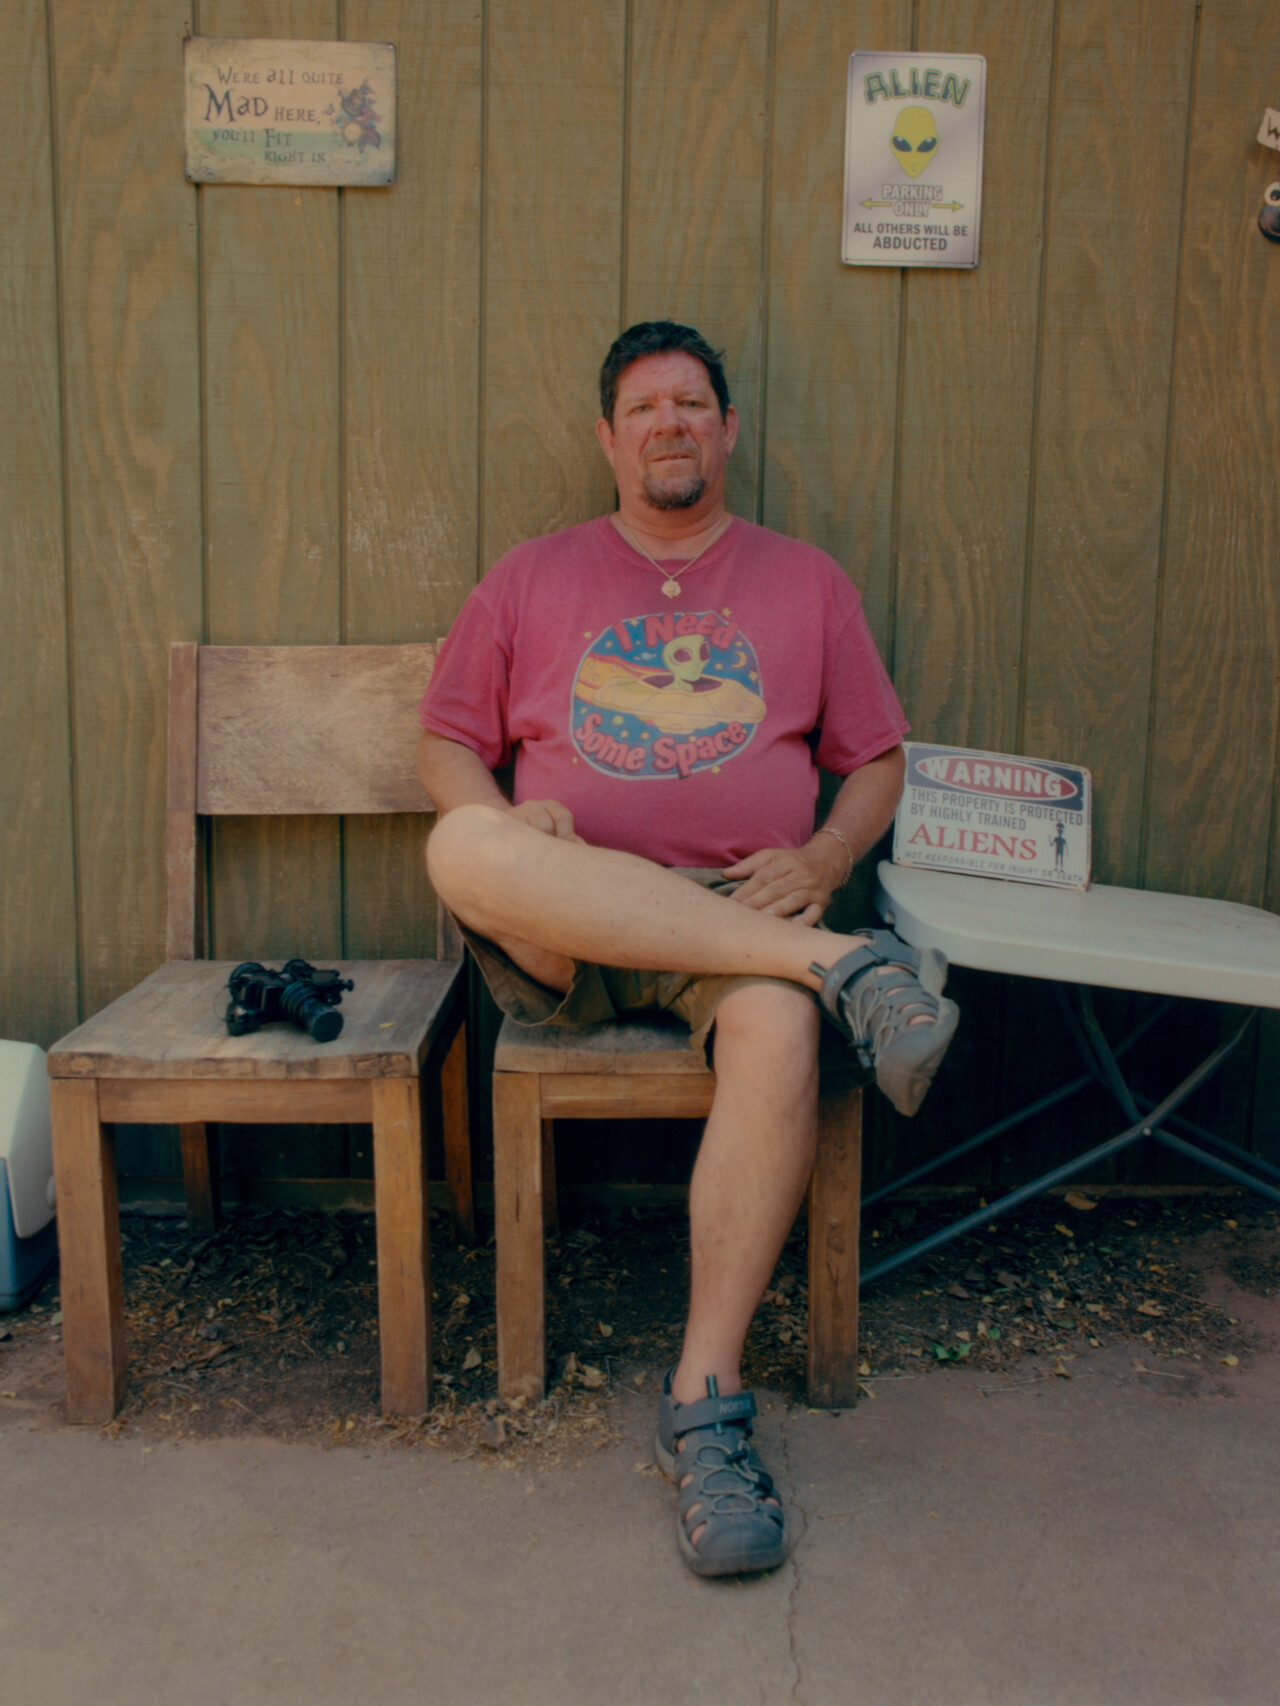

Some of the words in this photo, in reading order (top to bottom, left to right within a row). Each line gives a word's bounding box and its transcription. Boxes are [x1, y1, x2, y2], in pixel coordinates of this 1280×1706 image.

[301, 71, 343, 85] QUITE
[864, 67, 971, 108] ALIEN
[264, 150, 304, 163] RIGHT
[311, 151, 326, 163] IN
[882, 183, 943, 201] PARKING
[893, 201, 931, 217] ONLY
[853, 222, 874, 234] ALL
[876, 223, 921, 235] OTHERS
[923, 224, 950, 236] WILL
[953, 225, 969, 237] BE
[873, 236, 948, 251] ABDUCTED
[612, 621, 634, 653] I
[643, 613, 739, 652] Need
[575, 712, 648, 773] Some
[651, 720, 748, 779] Space
[924, 758, 1063, 798] WARNING
[910, 802, 925, 816] BY
[929, 805, 973, 823] HIGHLY
[977, 812, 1026, 831] TRAINED
[911, 788, 938, 804] THIS
[941, 792, 1001, 813] PROPERTY
[1003, 801, 1017, 814] IS
[1019, 804, 1083, 826] PROTECTED
[907, 822, 1038, 861] ALIENS
[904, 850, 923, 861] NOT
[988, 861, 1006, 872] FOR
